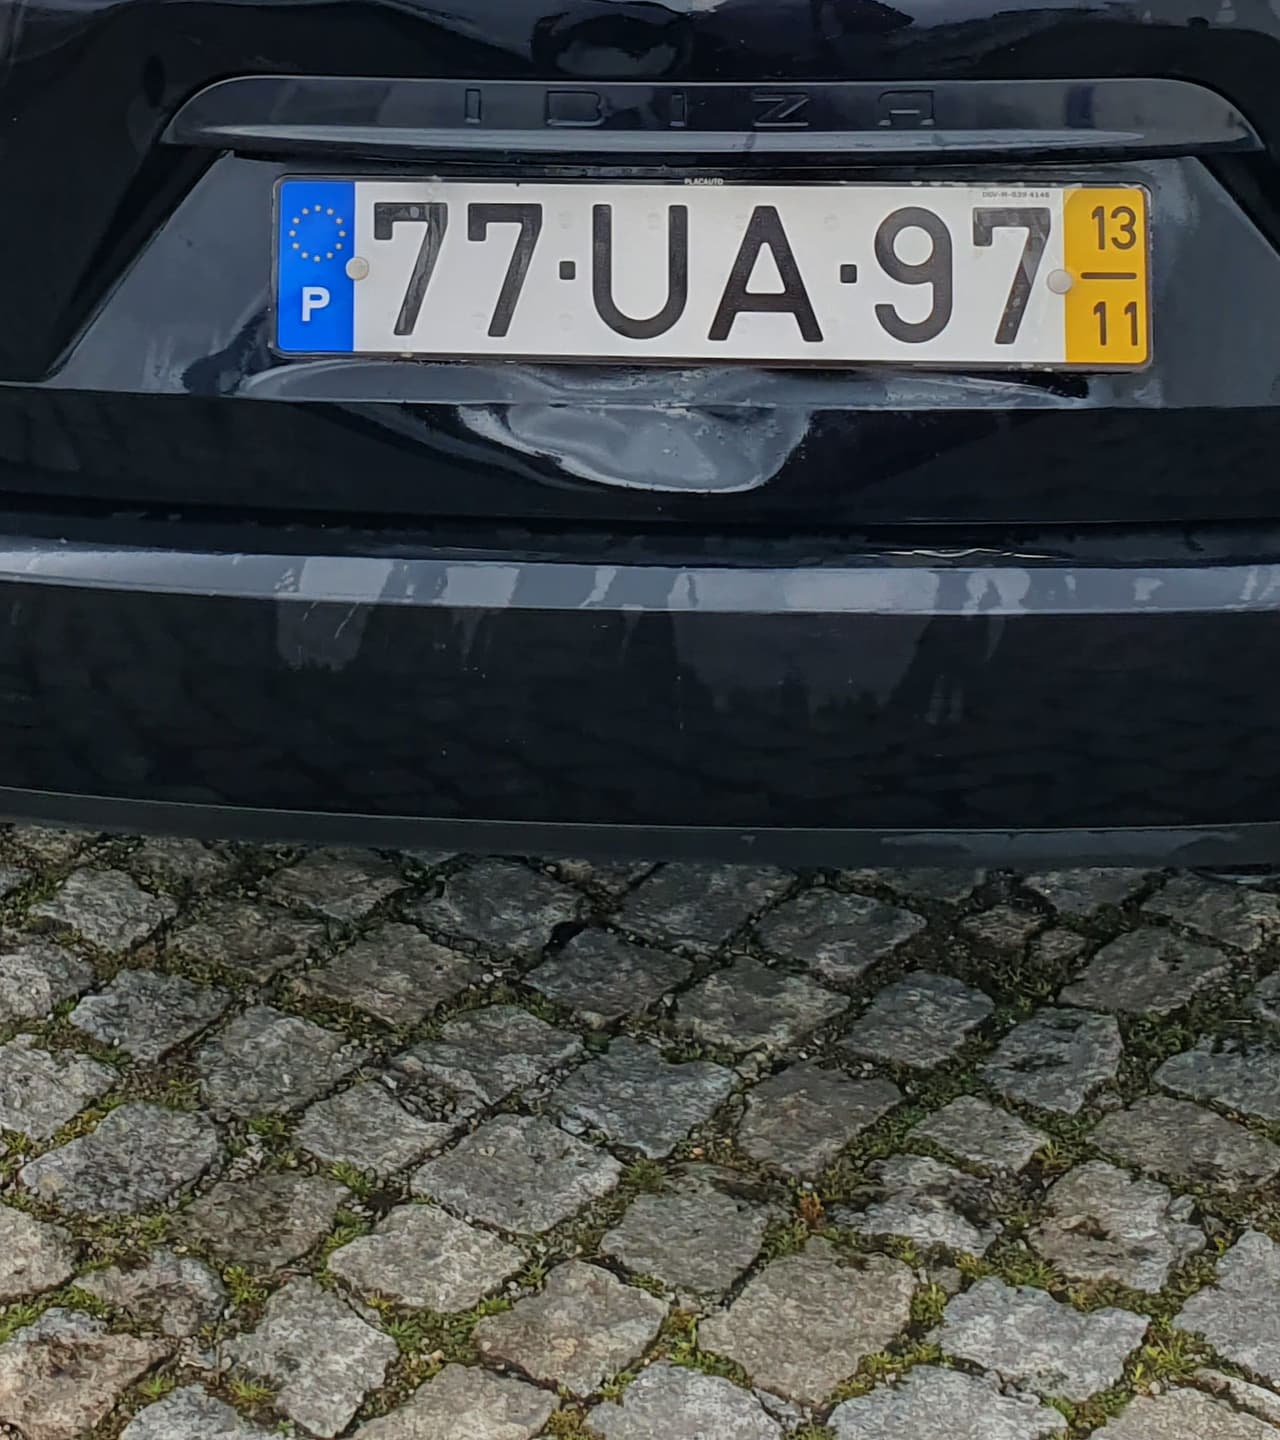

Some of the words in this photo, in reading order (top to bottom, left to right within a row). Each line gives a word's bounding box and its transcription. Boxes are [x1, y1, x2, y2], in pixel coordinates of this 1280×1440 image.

[463, 87, 936, 128] IBIZA
[1091, 206, 1137, 250] 13
[302, 287, 331, 322] P
[1093, 301, 1138, 346] 11
